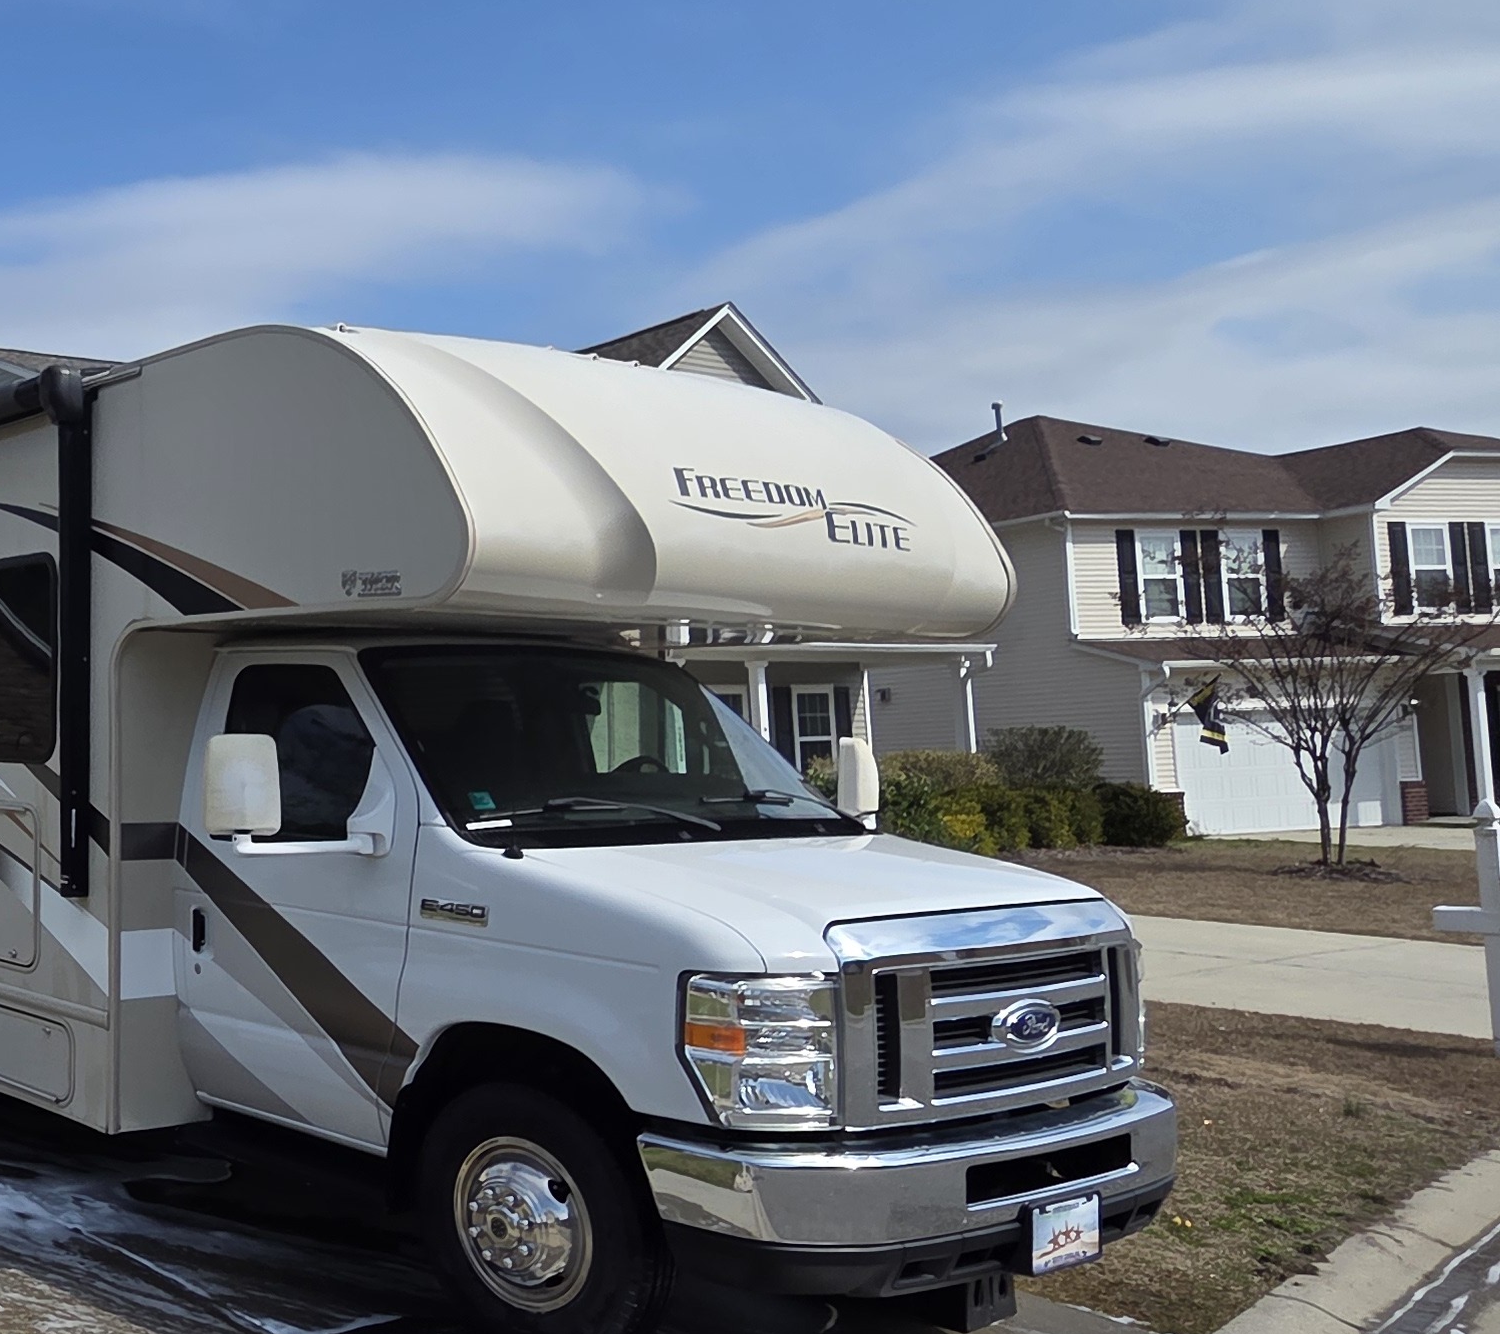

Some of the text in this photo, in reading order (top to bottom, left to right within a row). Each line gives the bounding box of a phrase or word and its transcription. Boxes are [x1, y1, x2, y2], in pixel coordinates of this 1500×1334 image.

[673, 466, 828, 510] FREEDOM
[824, 511, 911, 552] ELITE
[421, 898, 486, 918] E-450
[1022, 1013, 1050, 1036] Ford
